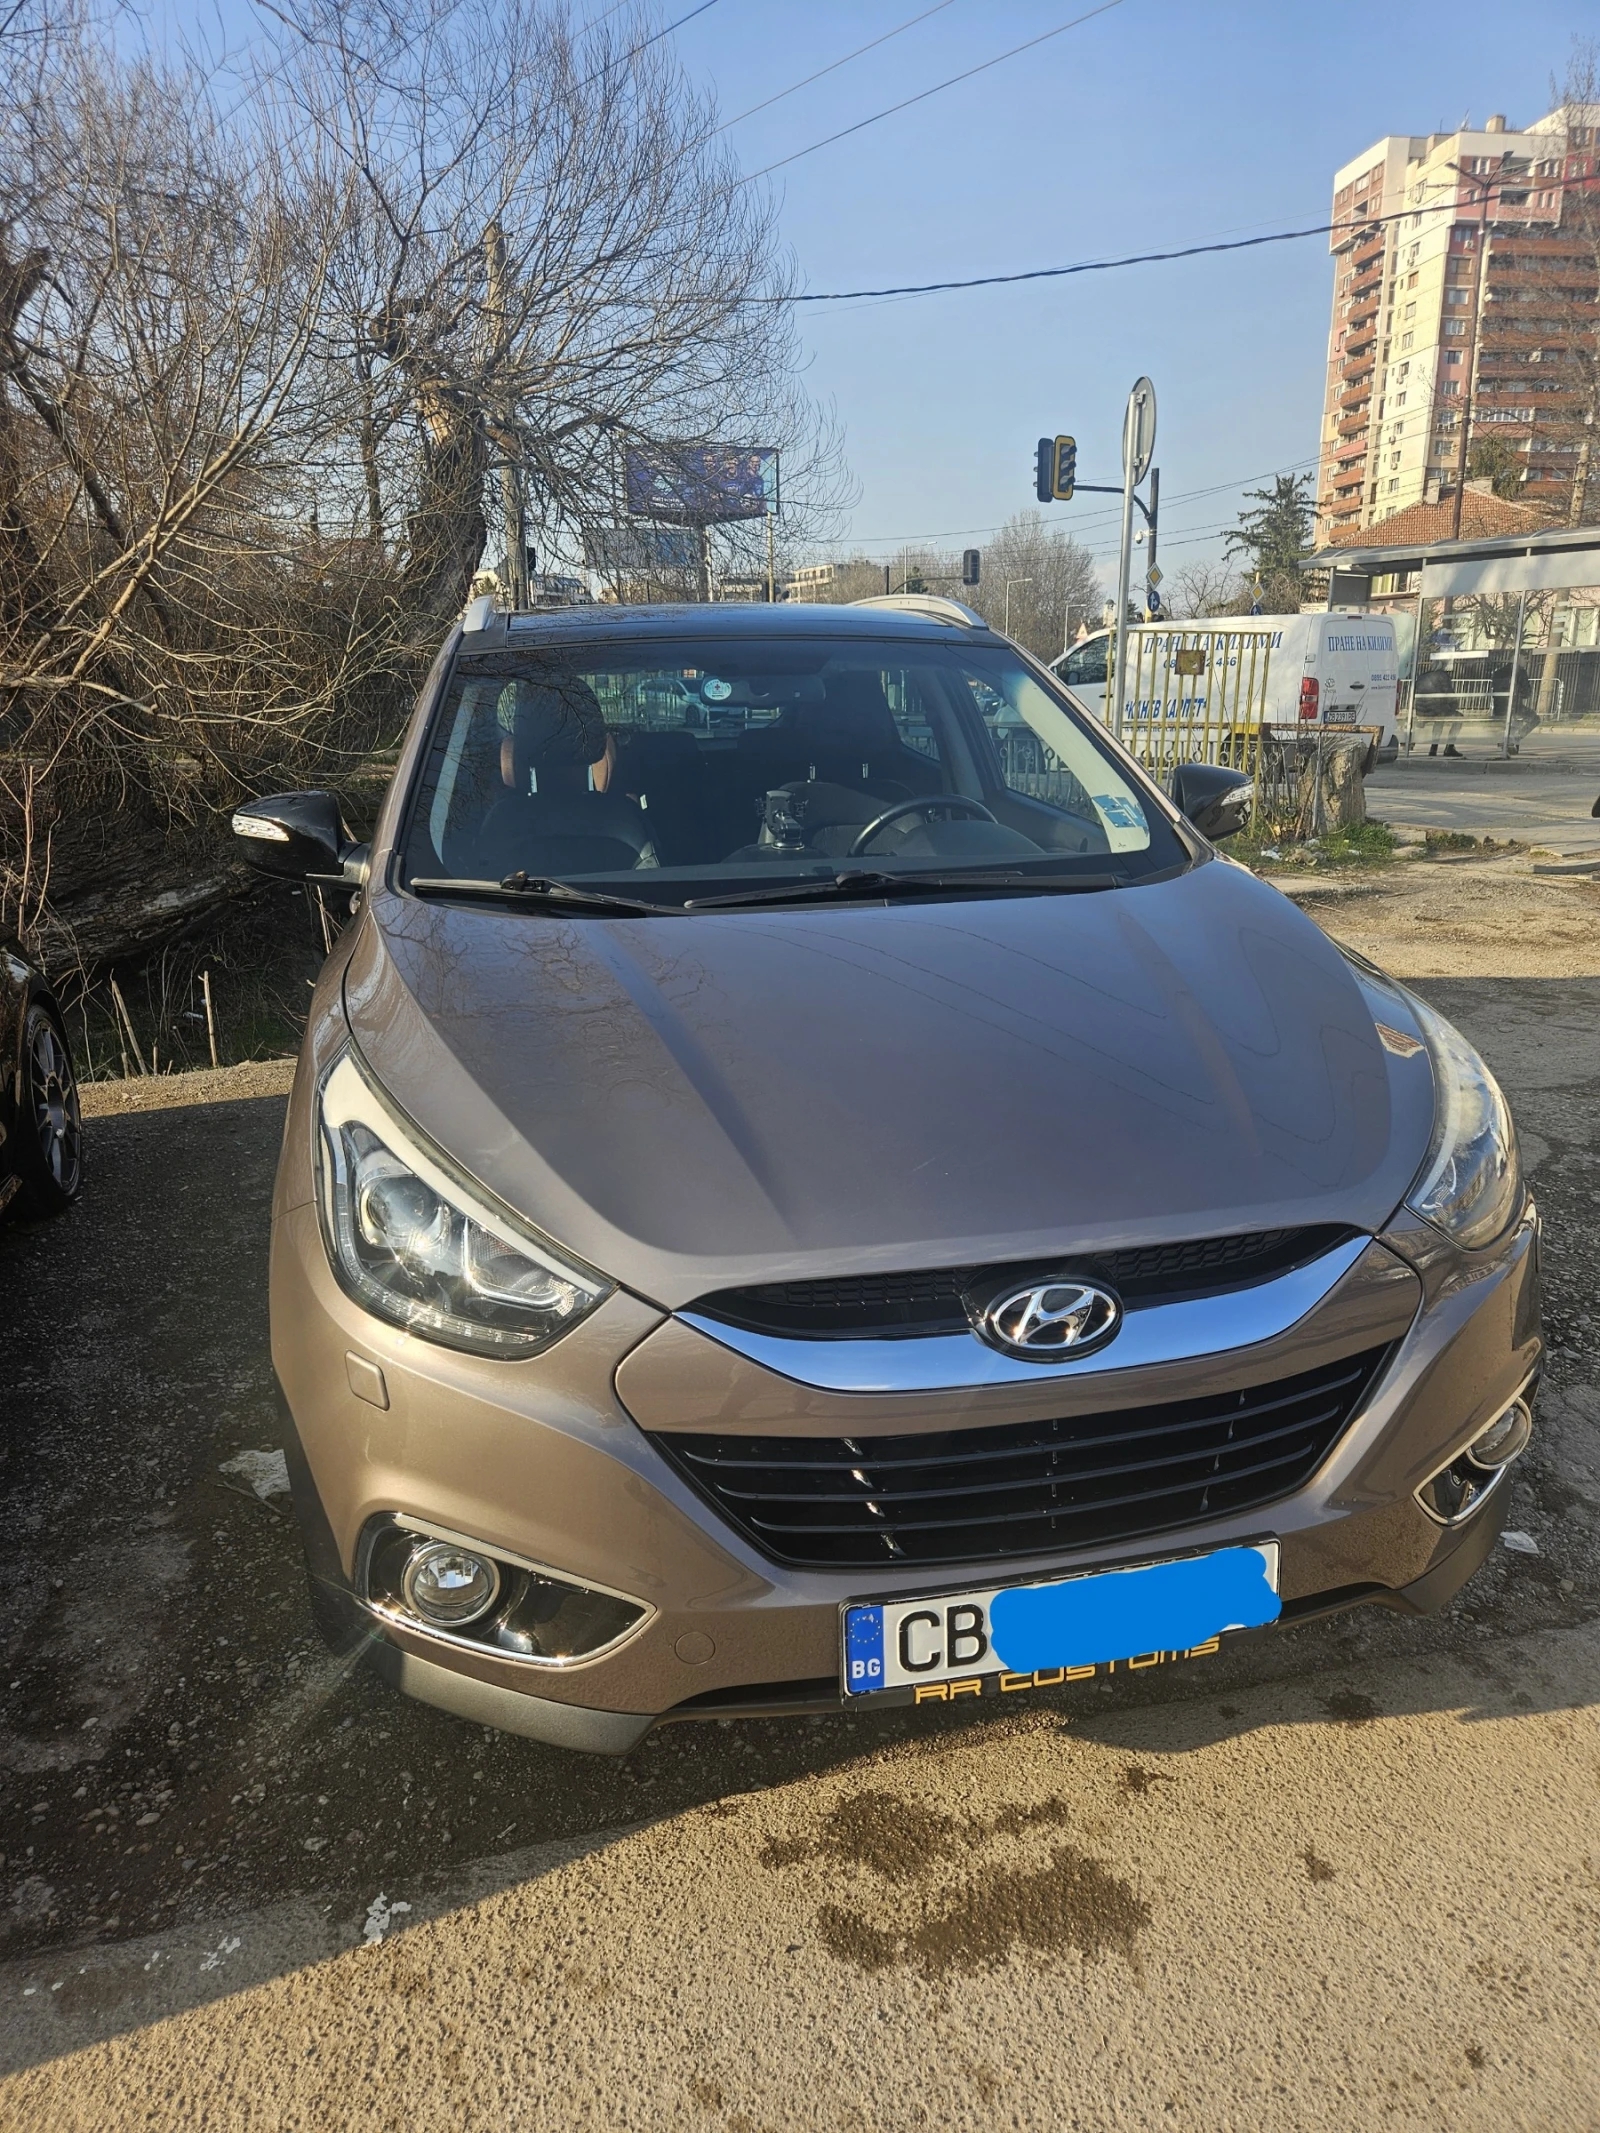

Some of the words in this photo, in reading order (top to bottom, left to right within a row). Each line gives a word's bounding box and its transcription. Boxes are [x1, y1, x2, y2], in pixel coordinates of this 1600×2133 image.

[1143, 635, 1188, 654] ПРАН
[1328, 636, 1355, 651] ПРАНЕ
[1356, 636, 1366, 651] НА
[898, 1603, 988, 1673] CB
[851, 1658, 881, 1679] BG
[915, 1678, 981, 1704] RR
